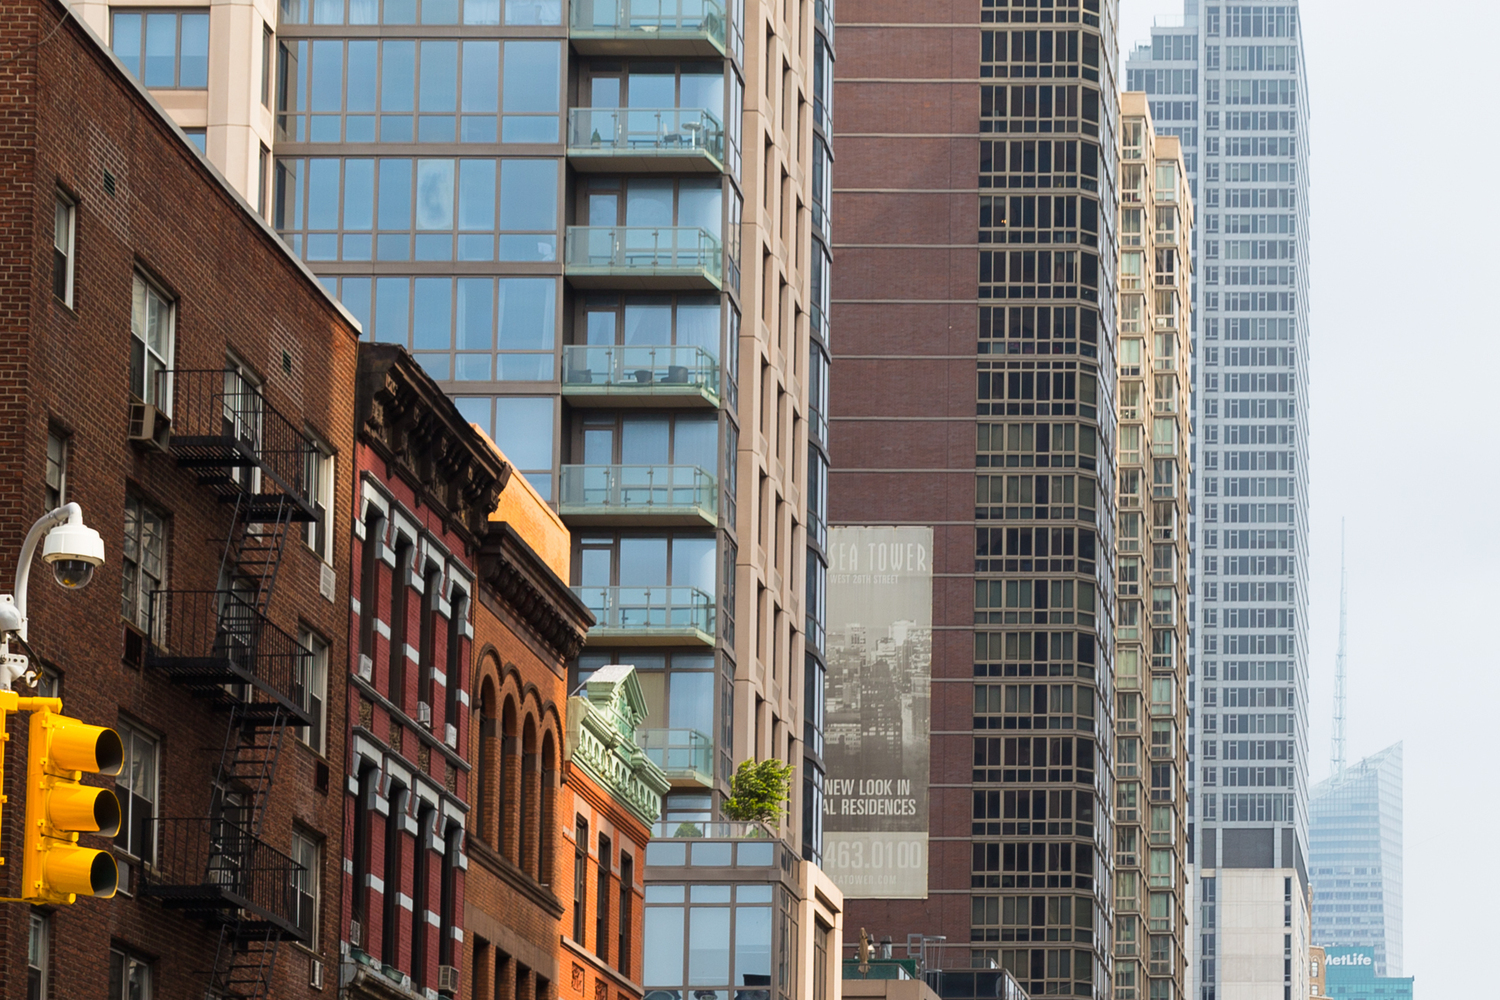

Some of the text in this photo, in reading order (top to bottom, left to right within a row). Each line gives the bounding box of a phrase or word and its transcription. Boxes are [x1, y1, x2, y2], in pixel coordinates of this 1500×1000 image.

[868, 542, 927, 571] TOWER
[830, 574, 851, 584] WEST
[873, 574, 899, 584] STREET
[824, 779, 911, 796] NEW LOOK IN
[841, 799, 917, 815] RESIDENCES
[824, 841, 922, 869] 463.0100
